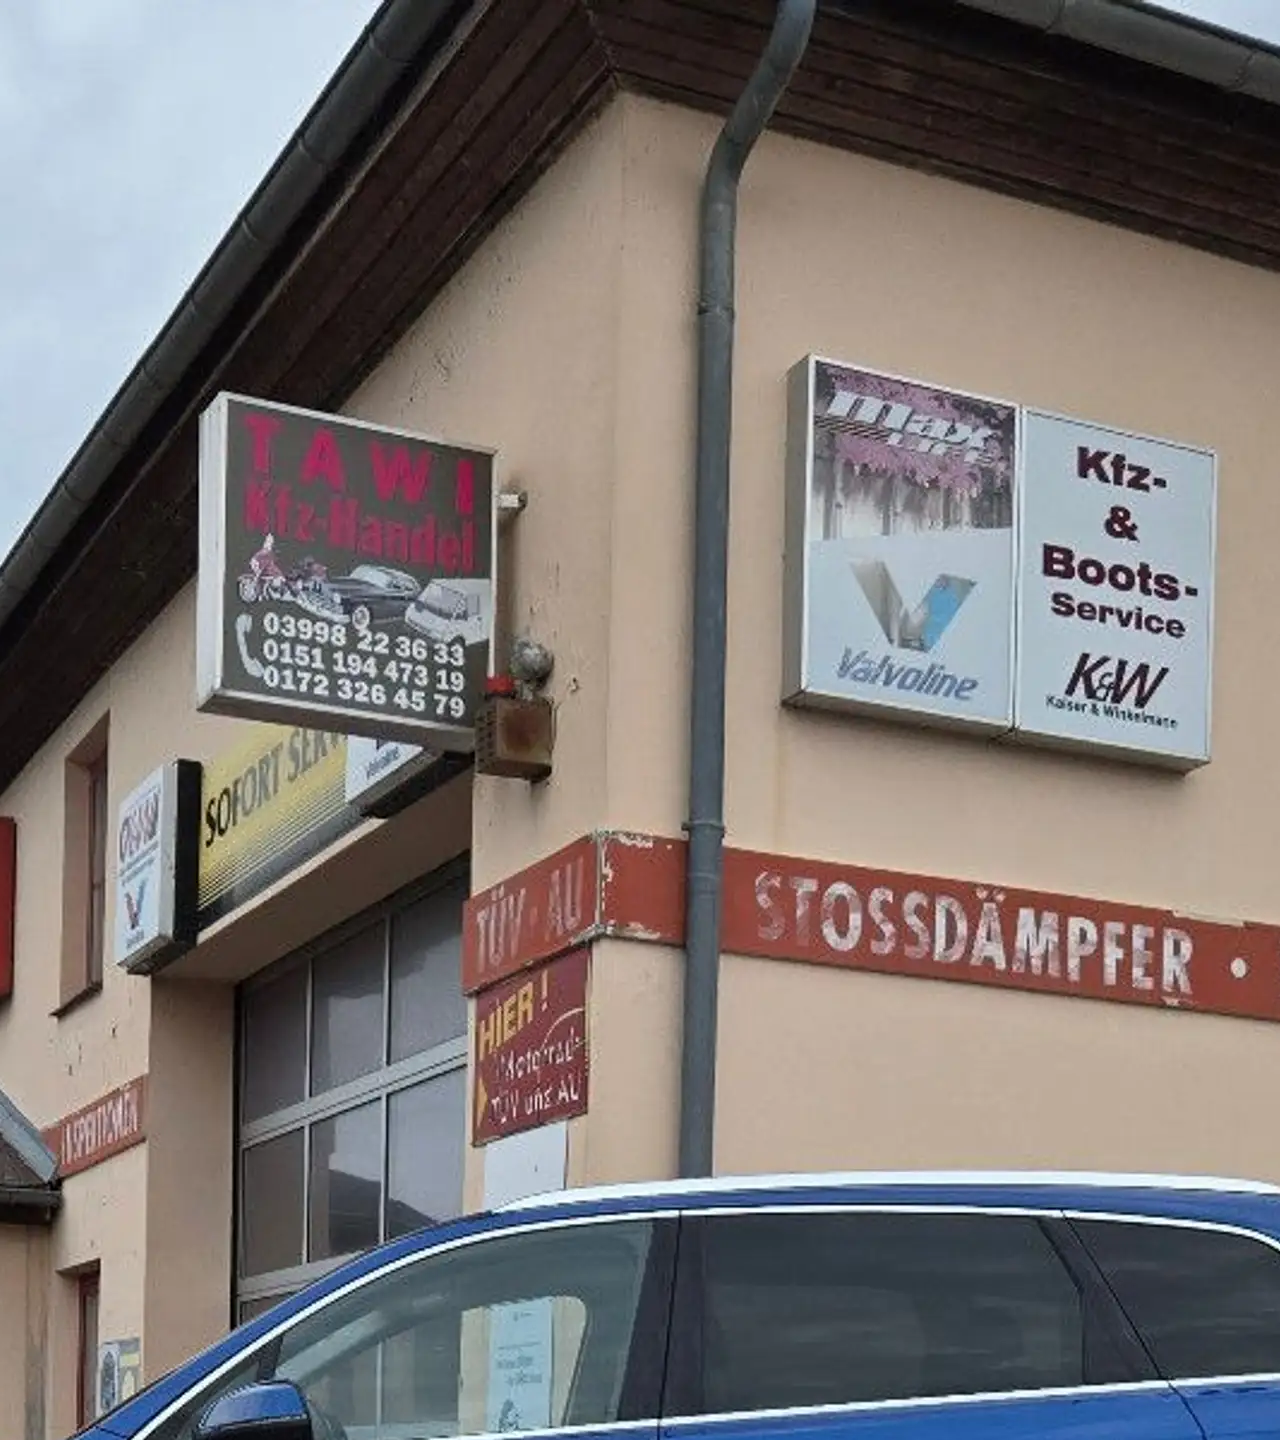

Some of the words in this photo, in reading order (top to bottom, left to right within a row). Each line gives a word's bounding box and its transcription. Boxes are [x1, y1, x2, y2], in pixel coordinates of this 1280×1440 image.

[1076, 445, 1168, 493] Kfz-
[242, 478, 478, 573] Kfz-Handel
[1104, 505, 1139, 542] &
[1042, 544, 1199, 602] Boots-
[263, 612, 347, 647] 03998
[357, 629, 390, 655] 22
[396, 636, 428, 661] 36
[433, 643, 465, 667] 33
[1050, 592, 1187, 639] Service
[263, 638, 324, 670] 0151
[332, 651, 378, 679] 194
[384, 660, 428, 687] 473
[436, 669, 465, 693] 19
[263, 665, 329, 696] 0172
[337, 678, 387, 705] 326
[393, 688, 426, 712] 45
[433, 694, 465, 719] 79
[836, 647, 979, 701] Valvoline
[204, 740, 284, 848] SOFORT
[753, 871, 1193, 996] STOSSDÄMPFER
[479, 982, 534, 1061] HIER
